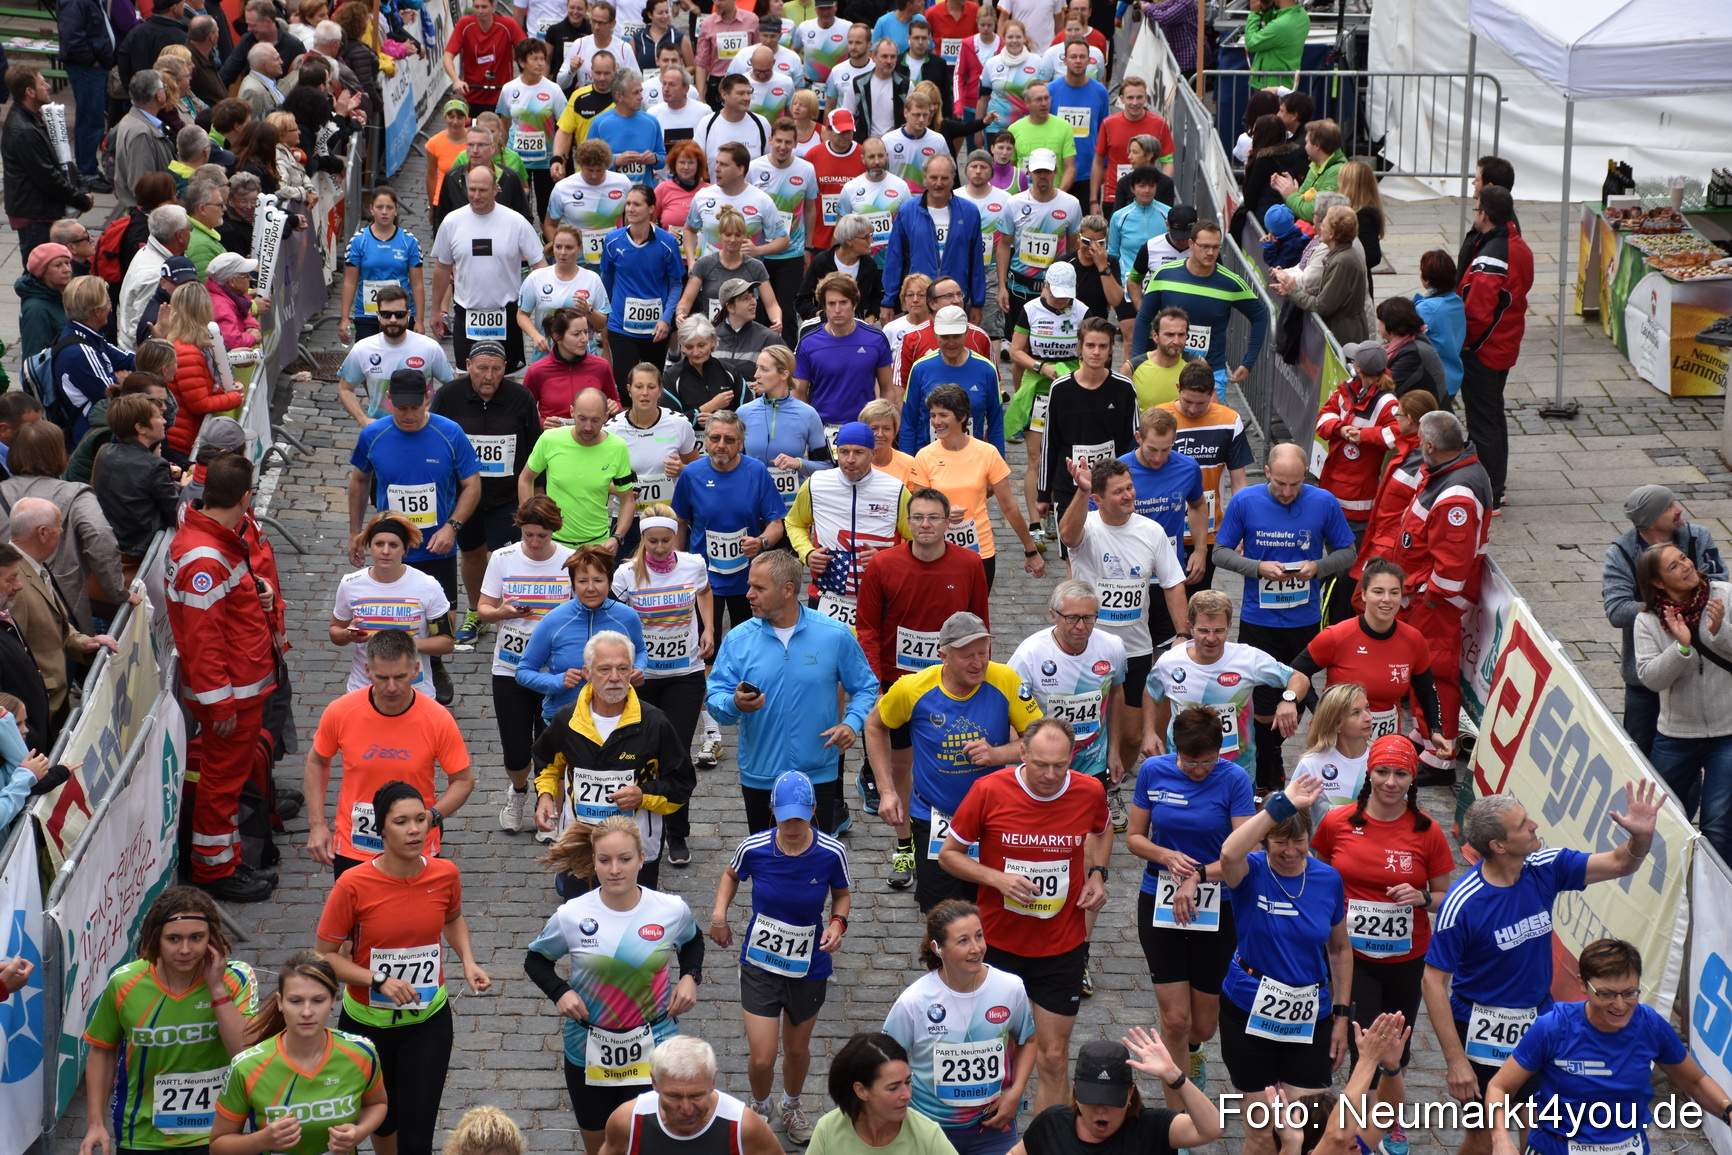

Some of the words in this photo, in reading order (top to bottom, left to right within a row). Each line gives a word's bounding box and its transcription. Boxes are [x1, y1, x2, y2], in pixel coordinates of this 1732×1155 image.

[723, 38, 742, 49] 367
[944, 45, 960, 55] 309
[1064, 114, 1085, 127] 517
[517, 138, 543, 150] 2628
[825, 203, 837, 213] 26
[871, 219, 890, 232] 30
[591, 238, 604, 251] 31
[1027, 241, 1049, 255] 119
[1027, 256, 1046, 264] Thomas
[471, 312, 503, 326] 2080
[629, 307, 660, 320] 2096
[474, 329, 499, 337] Wolfgang
[1034, 340, 1077, 349] Laufteam
[1185, 334, 1206, 349] 253
[1043, 348, 1069, 356] Fürth
[1672, 355, 1728, 389] Lammsb
[476, 446, 502, 461] 486
[1177, 445, 1220, 454] Fischer
[774, 475, 795, 492] 99
[398, 495, 429, 512] 158
[1134, 505, 1170, 514] ettenhofen
[407, 515, 423, 523] ranz
[945, 529, 974, 548] 396
[1256, 530, 1295, 539] Kirwaläufer
[1256, 539, 1296, 547] Pettenhofen
[508, 582, 532, 595] LÄUFT
[533, 584, 548, 595] BEI
[549, 584, 563, 595] MIR
[637, 594, 662, 607] LÄUFT
[663, 594, 676, 605] BEI
[677, 592, 691, 603] MIR
[1101, 590, 1143, 608] 2298
[356, 604, 378, 617] LÄUFT
[381, 605, 396, 617] BEI
[397, 606, 412, 617] MIR
[1110, 611, 1132, 620] Hubert
[503, 625, 518, 634] PARTL
[898, 630, 916, 639] PARTL
[646, 639, 686, 658] 2425
[655, 661, 675, 669] Krissi
[1219, 675, 1240, 683] Hervis
[1048, 697, 1067, 705] PARTL
[1068, 696, 1095, 705] Neumarkt
[1053, 703, 1097, 723] 2544
[1372, 719, 1397, 738] 785
[378, 748, 412, 760] asics
[354, 806, 374, 814] PARTL
[366, 838, 384, 849] Mich
[1002, 832, 1072, 847] NEUMARKT
[1006, 863, 1029, 873] PARTL
[1029, 866, 1060, 874] Neumarkt
[1025, 875, 1058, 896] 09
[1162, 885, 1215, 909] 297
[1350, 904, 1371, 912] PARTL
[1372, 906, 1403, 914] Neumarkt
[641, 928, 662, 936] Hervis
[757, 918, 777, 930] PARTL
[777, 925, 808, 938] Neumarkt
[1354, 914, 1408, 938] 2243
[1494, 910, 1551, 944] HUBER
[756, 929, 809, 958] 2314
[1365, 941, 1394, 951] Karola
[372, 952, 396, 960] PARTL
[398, 952, 429, 961] Neumarkt
[764, 953, 791, 970] Nicole
[1261, 982, 1282, 996] PARTL
[1259, 994, 1314, 1021] 2288
[1474, 1006, 1496, 1018] PARTL
[1498, 1011, 1528, 1021] Neumarkt
[133, 1021, 220, 1046] BOCK
[1260, 1019, 1303, 1035] Hildegard
[589, 1031, 610, 1044] PARTL
[610, 1033, 642, 1045] Neumarkt
[600, 1042, 642, 1066] 309
[935, 1048, 960, 1057] PARTL
[960, 1046, 994, 1056] Neumarkt
[604, 1068, 638, 1079] Simone
[941, 1054, 1000, 1083] 2339
[156, 1078, 183, 1087] PARTL
[184, 1075, 220, 1085] Neumarkt
[953, 1087, 989, 1098] Daniela
[265, 1094, 356, 1125] BOCK
[176, 1116, 209, 1126] Simon
[1570, 1144, 1598, 1152] PARTL
[1599, 1142, 1630, 1152] Neumarkt
